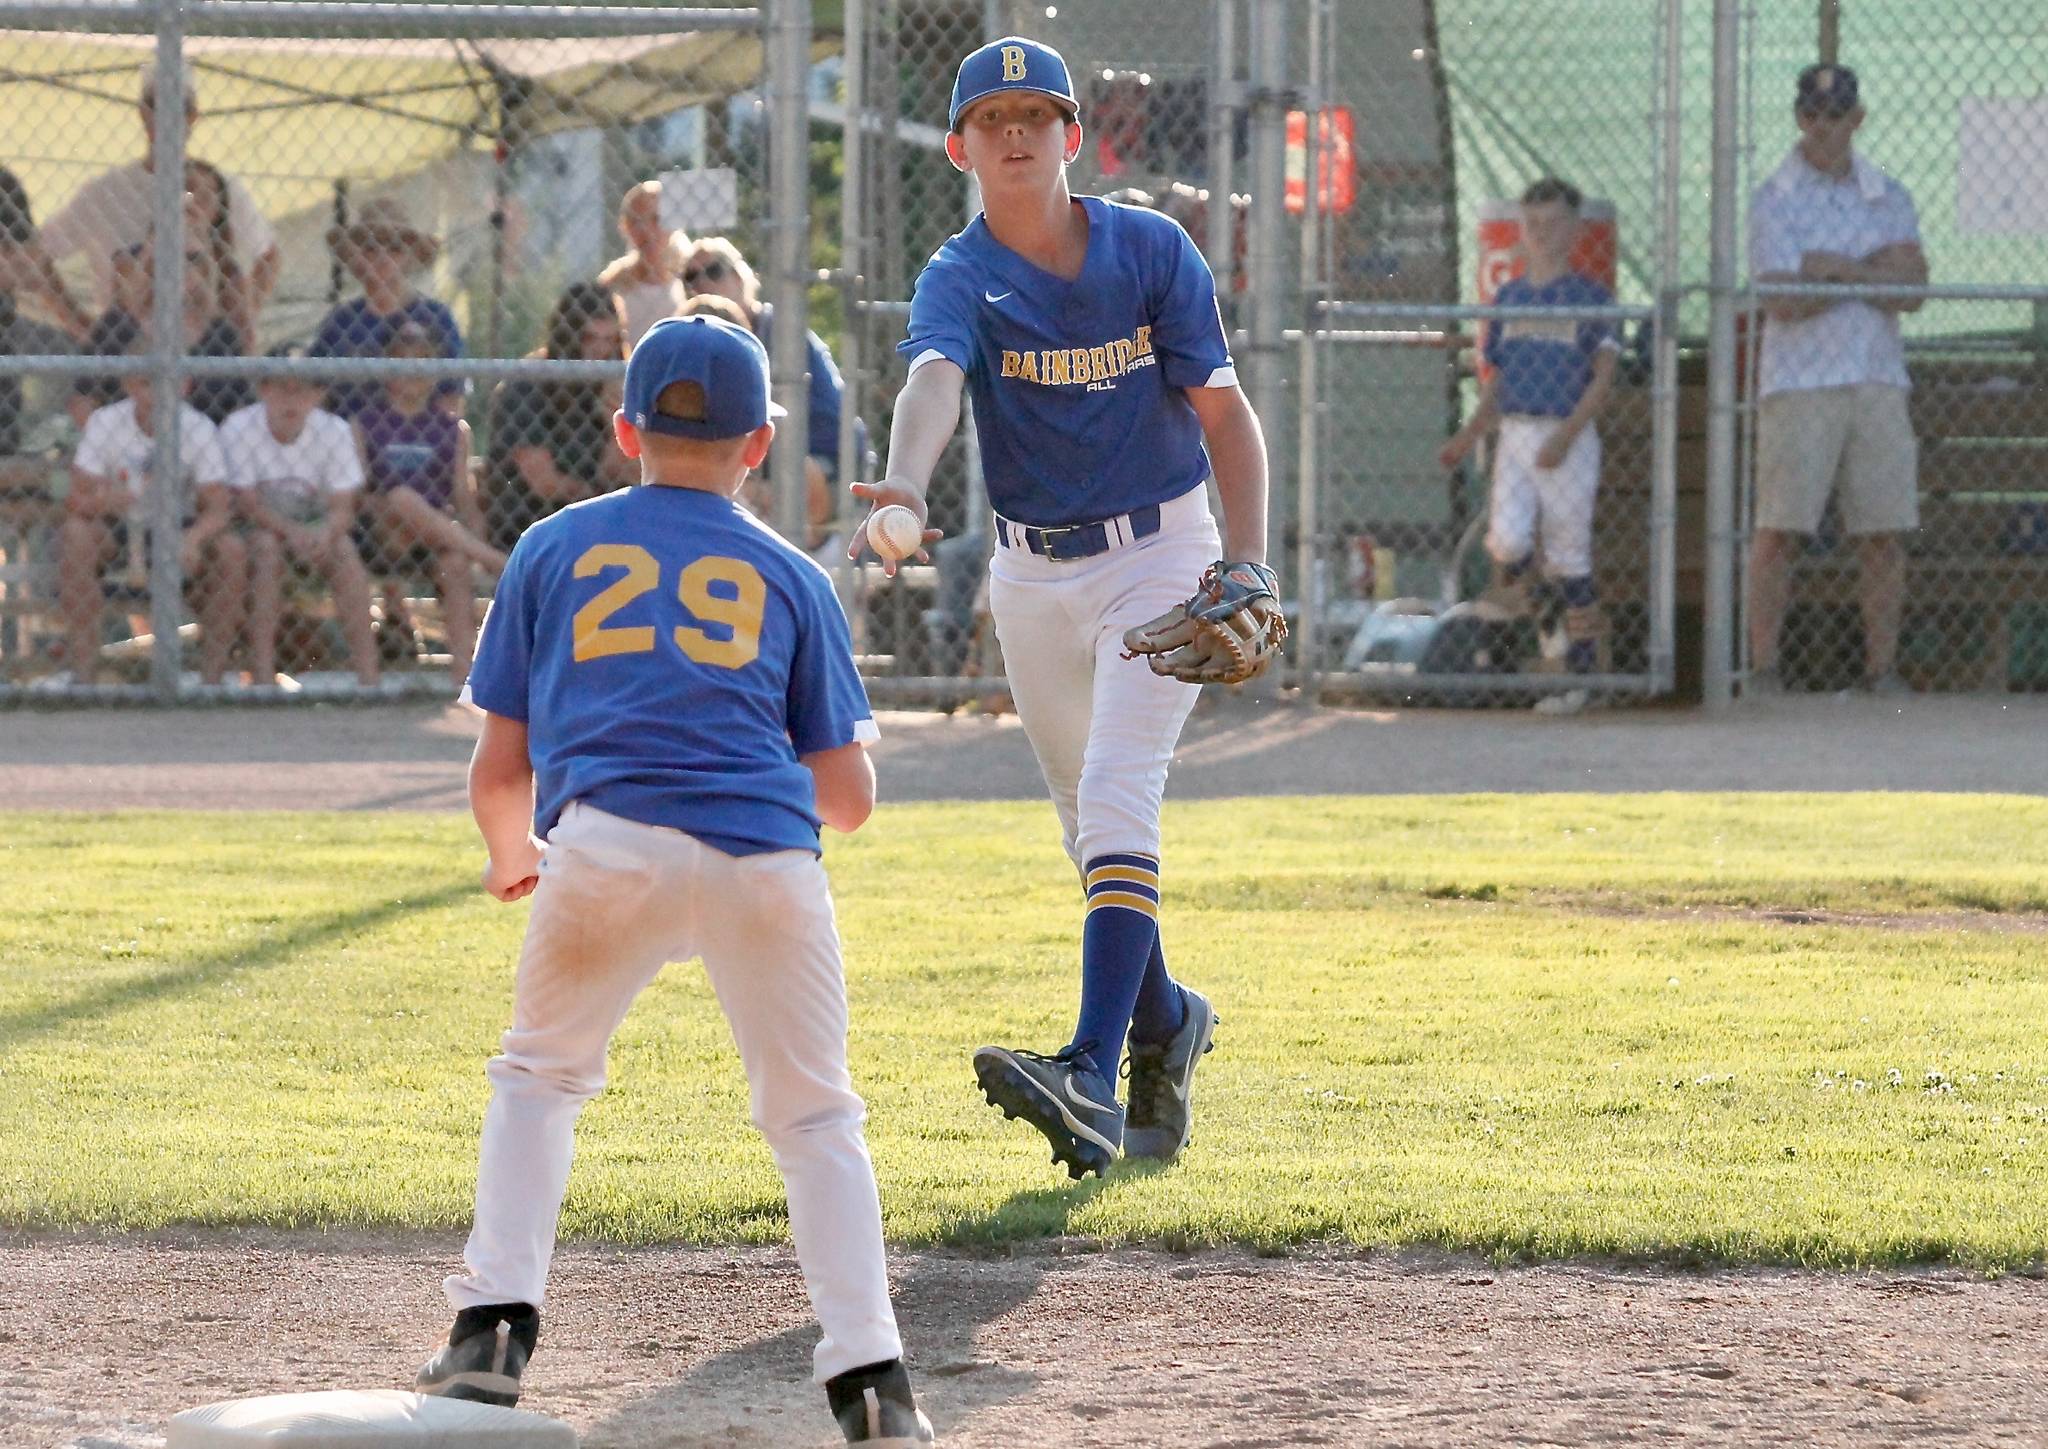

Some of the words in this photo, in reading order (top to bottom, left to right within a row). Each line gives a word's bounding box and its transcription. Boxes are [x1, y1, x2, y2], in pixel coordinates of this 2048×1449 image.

[1001, 46, 1027, 81] B
[1086, 380, 1117, 392] ALL
[572, 543, 767, 671] 29
